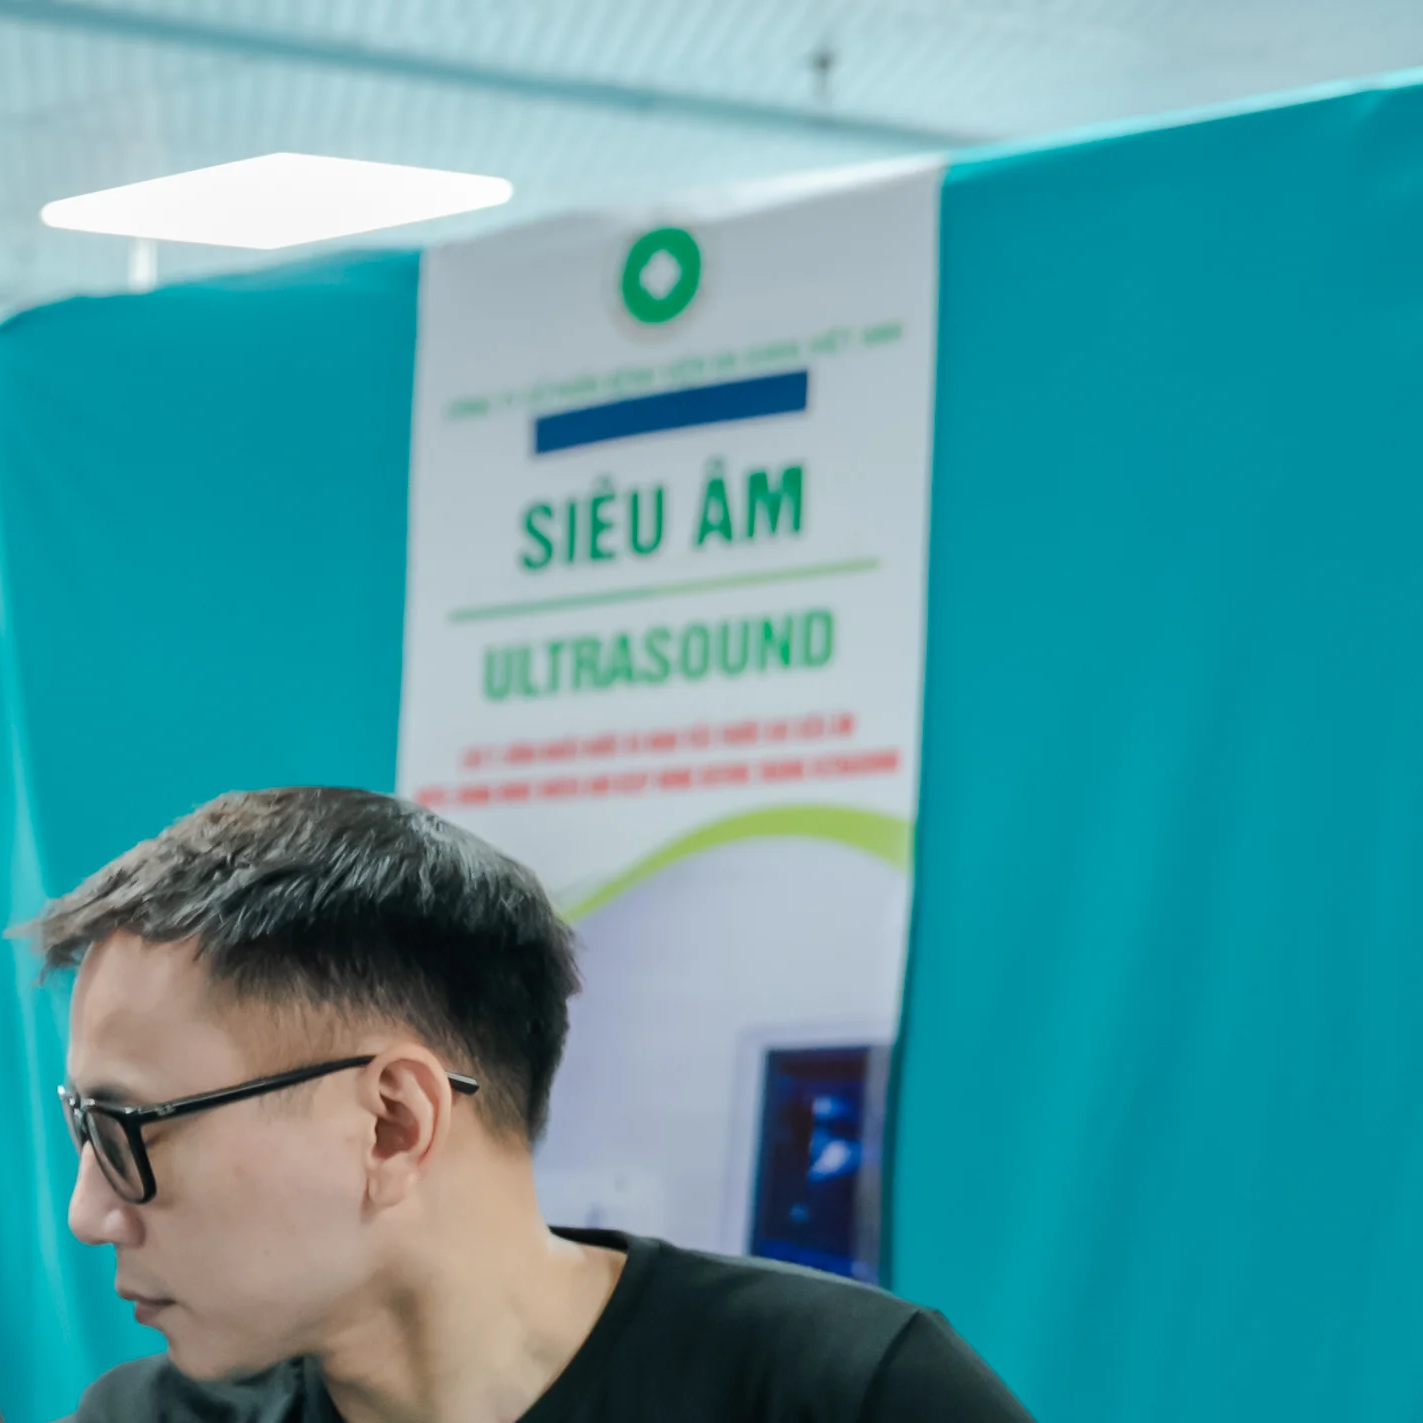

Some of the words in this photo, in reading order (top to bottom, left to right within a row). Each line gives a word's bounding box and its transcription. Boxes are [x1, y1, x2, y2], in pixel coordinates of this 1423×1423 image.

[521, 474, 665, 570] SIÊU
[696, 457, 803, 546] ÂM
[481, 609, 836, 701] ULTRASOUND
